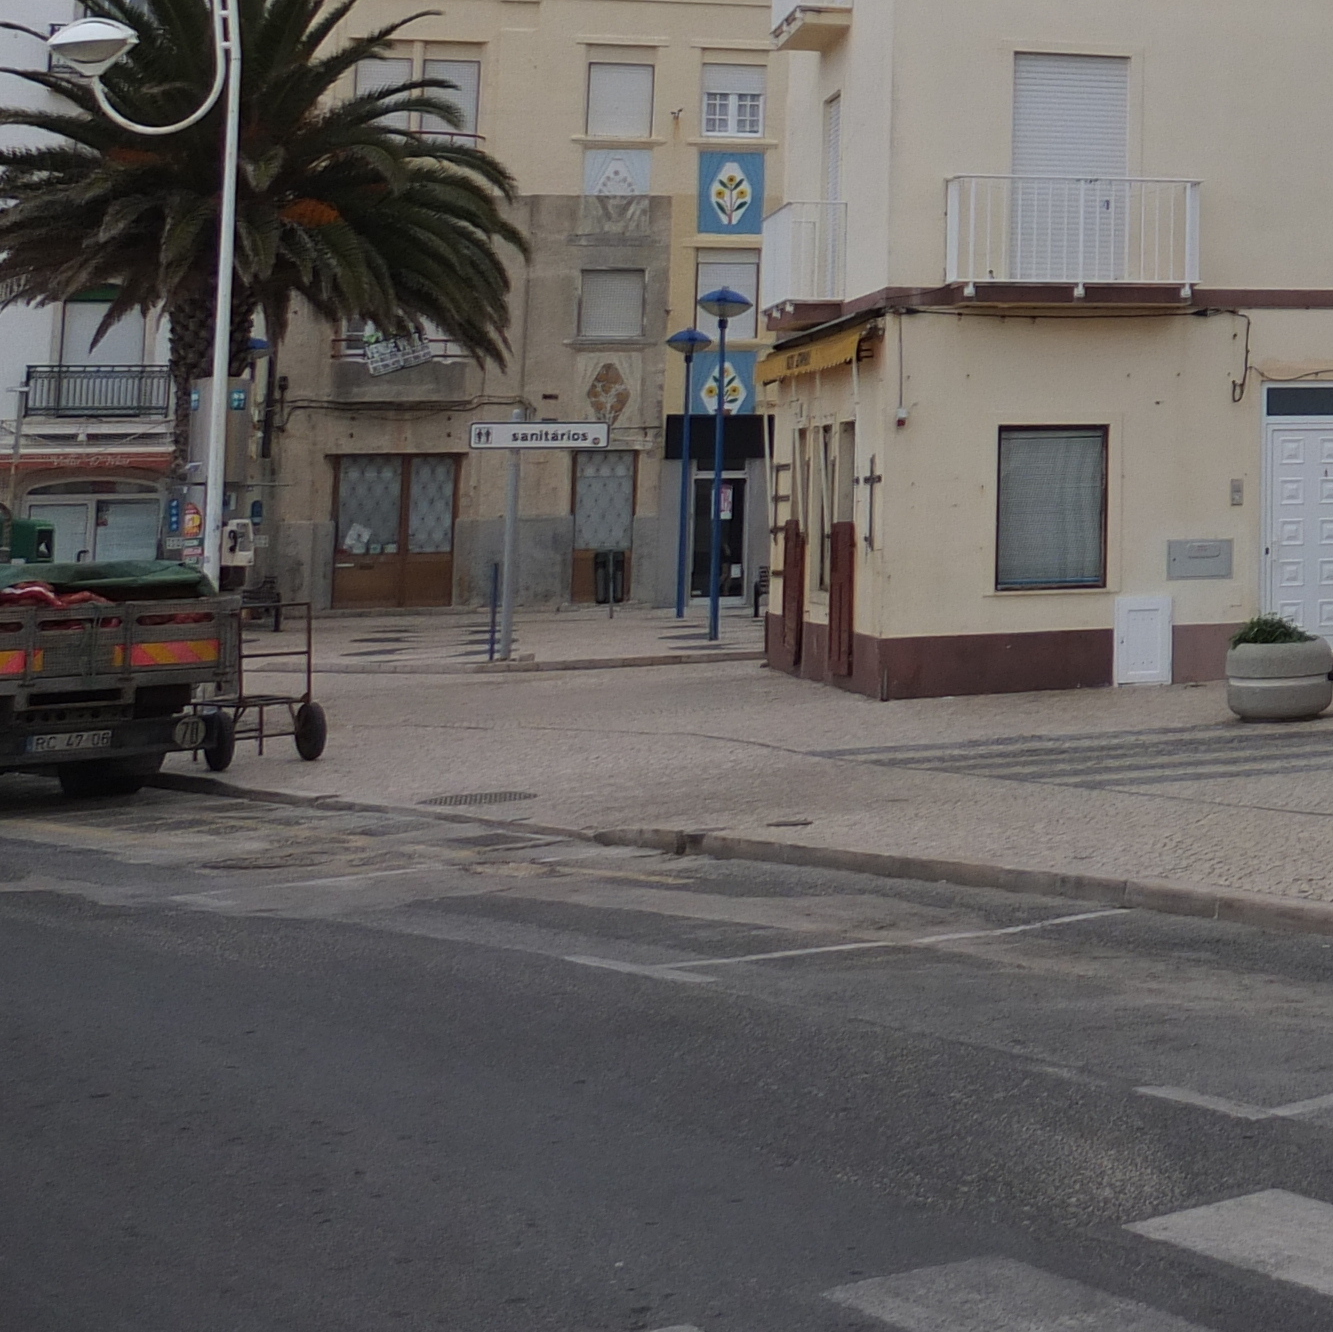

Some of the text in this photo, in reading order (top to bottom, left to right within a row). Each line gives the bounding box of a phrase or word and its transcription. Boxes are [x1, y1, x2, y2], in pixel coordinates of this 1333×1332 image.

[511, 430, 588, 442] sanitários
[35, 732, 110, 750] RC 47 06
[181, 721, 200, 744] 70
